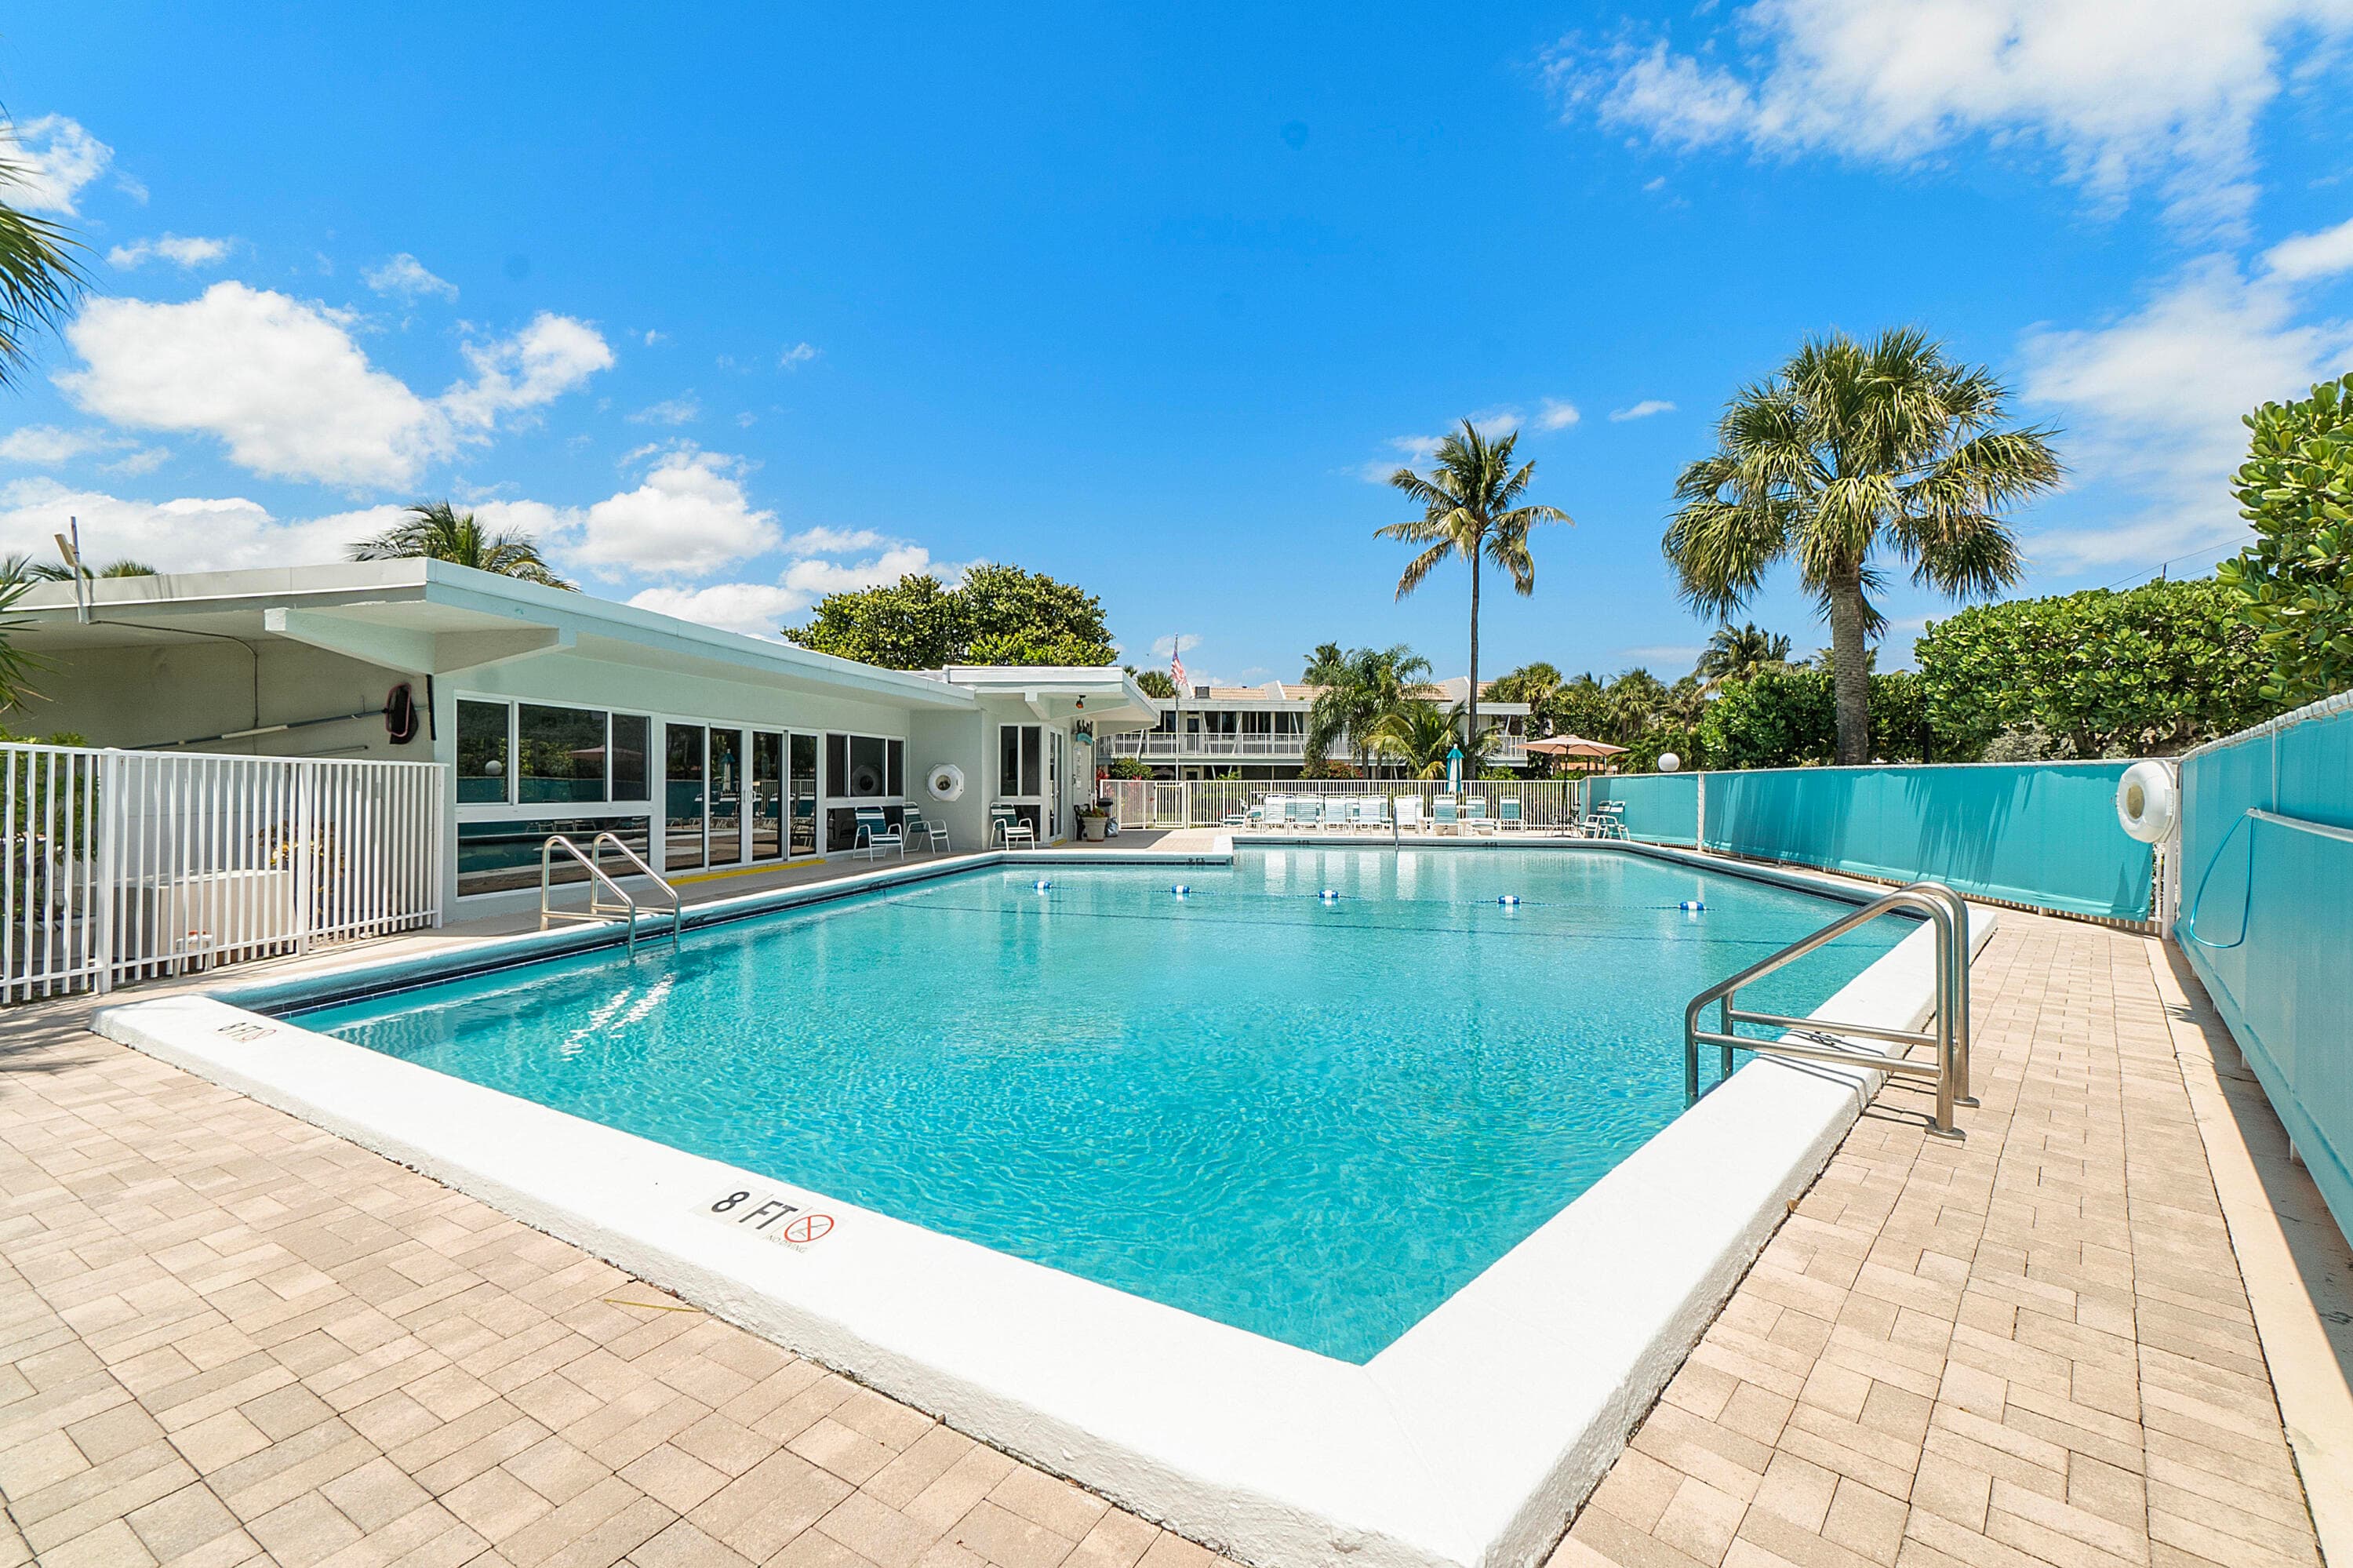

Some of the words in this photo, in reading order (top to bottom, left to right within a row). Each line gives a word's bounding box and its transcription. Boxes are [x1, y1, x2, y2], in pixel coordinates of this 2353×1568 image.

[225, 1025, 264, 1037] FT
[711, 1191, 751, 1213] 8
[738, 1200, 799, 1230] FT
[766, 1234, 781, 1243] NO
[779, 1239, 808, 1253] DIVING
